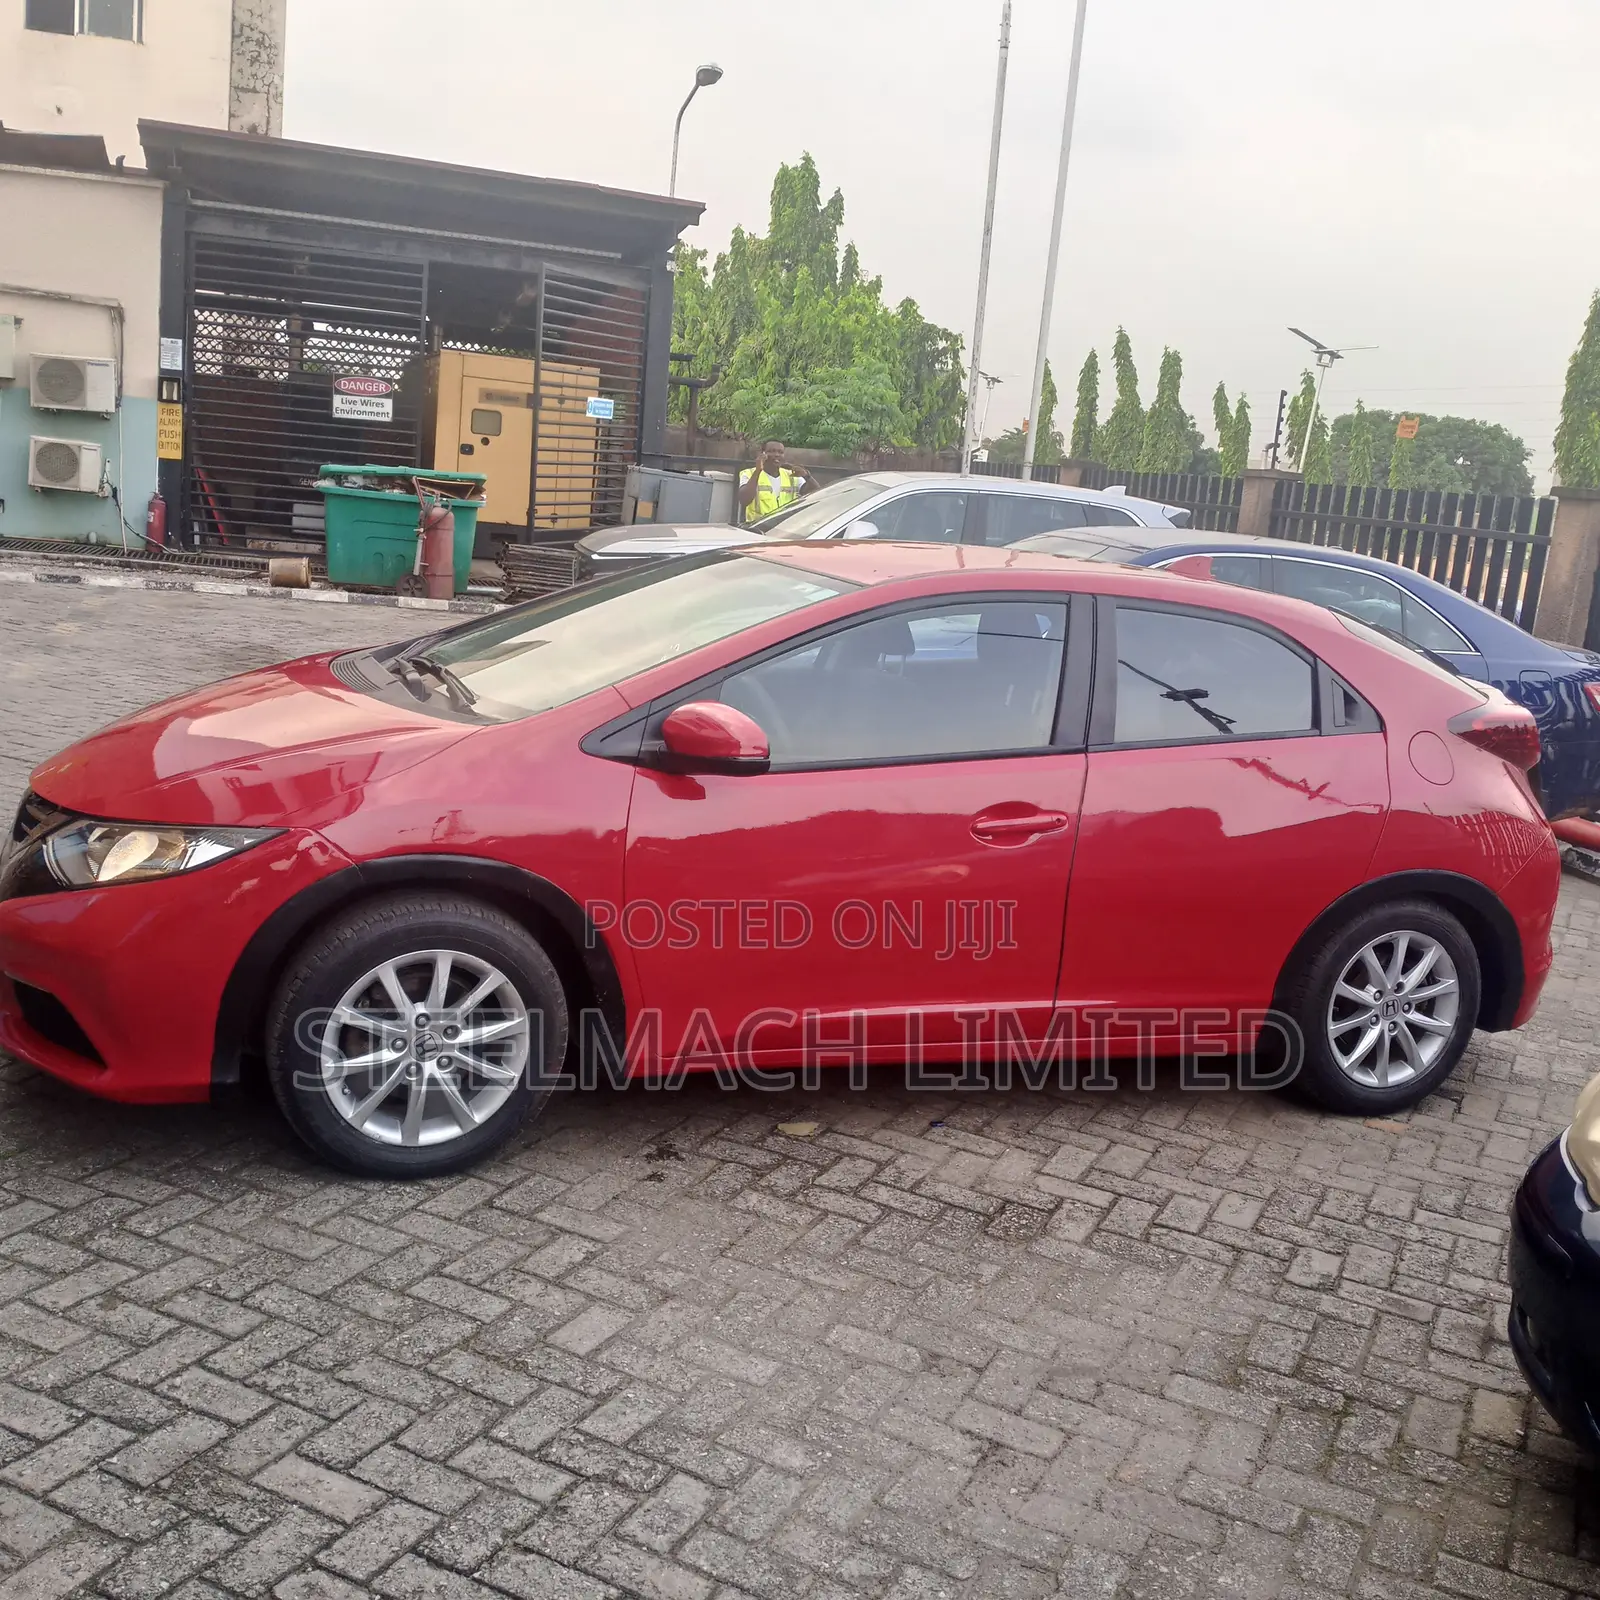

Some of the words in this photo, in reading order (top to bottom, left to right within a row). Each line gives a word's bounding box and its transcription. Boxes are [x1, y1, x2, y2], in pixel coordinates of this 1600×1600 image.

[340, 380, 386, 392] DANGER
[341, 397, 358, 406] Live
[360, 399, 385, 408] Wires
[161, 408, 181, 417] FIRE
[335, 407, 390, 418] Environment
[159, 429, 181, 438] PUSH
[158, 440, 180, 450] BUTTON
